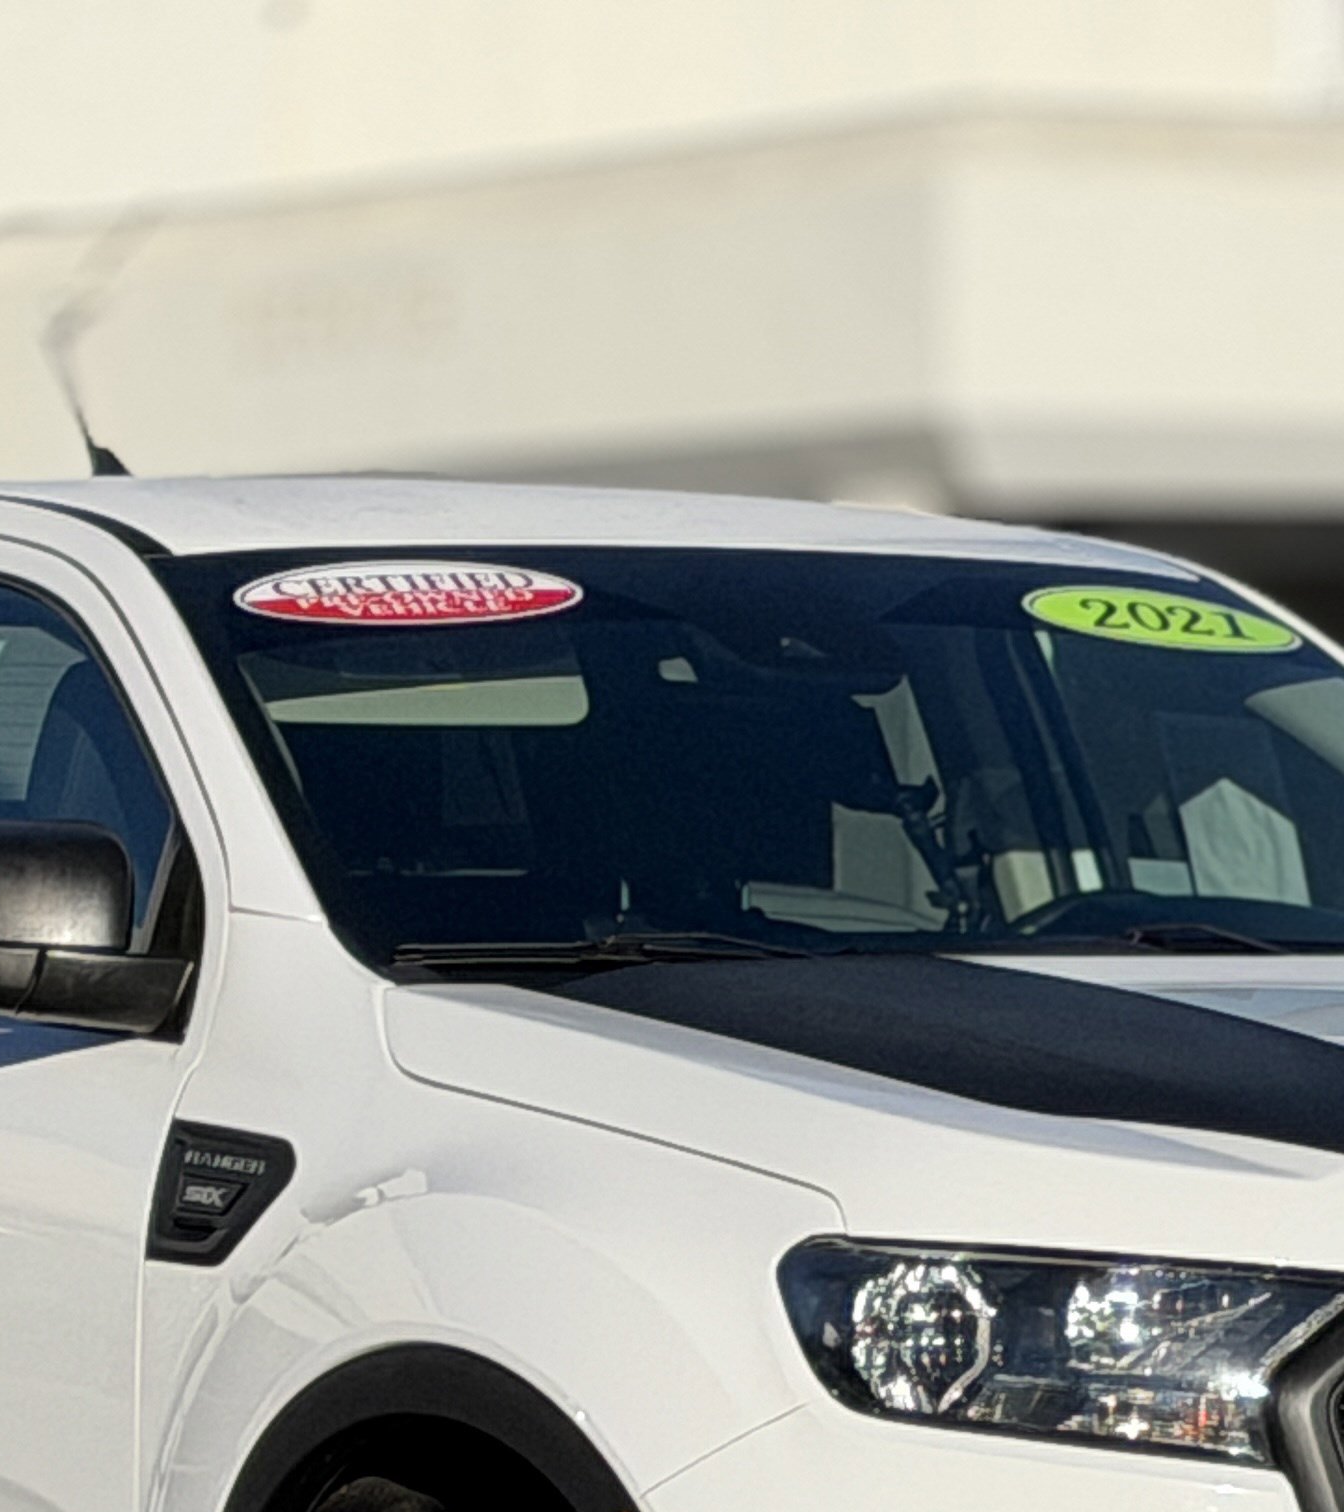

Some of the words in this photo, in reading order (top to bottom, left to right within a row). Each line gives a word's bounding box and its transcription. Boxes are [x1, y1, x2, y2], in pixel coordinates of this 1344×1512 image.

[271, 572, 534, 598] CERTIFIED
[1078, 597, 1257, 642] 2021
[183, 1150, 267, 1176] RANGER
[181, 1184, 230, 1208] STX
